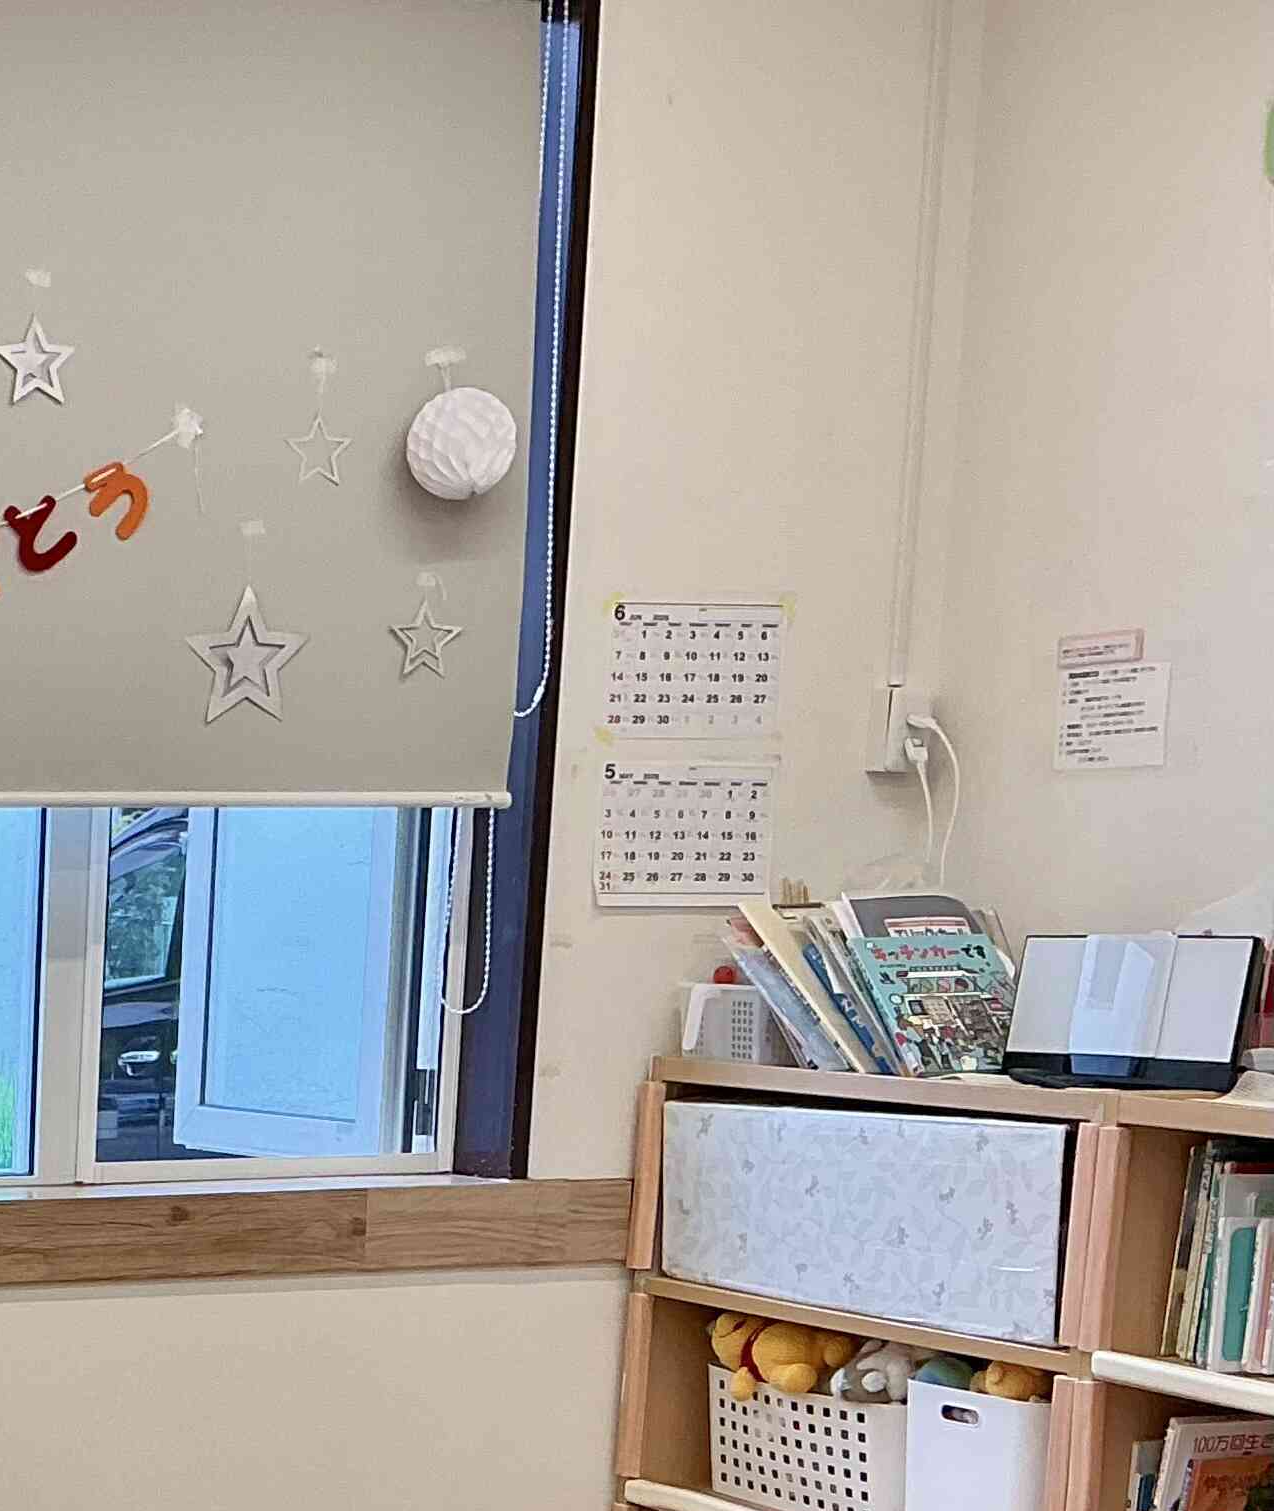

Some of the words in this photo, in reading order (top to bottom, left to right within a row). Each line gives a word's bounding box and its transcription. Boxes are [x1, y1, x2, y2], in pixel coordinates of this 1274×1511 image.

[614, 604, 626, 621] 6
[642, 630, 647, 640] 1
[665, 630, 673, 640] 2
[690, 631, 697, 640] 3
[714, 631, 721, 640] 4
[738, 631, 744, 641] 5
[761, 631, 768, 641] 6
[616, 651, 623, 660] 7
[639, 651, 646, 661] 8
[664, 651, 671, 661] 9
[685, 652, 698, 662] 10
[709, 652, 721, 662] 11
[734, 652, 746, 662] 12
[758, 652, 770, 662] 13
[611, 672, 624, 681] 14
[635, 672, 648, 682] 15
[659, 673, 672, 683] 16
[684, 673, 697, 683] 17
[707, 673, 720, 683] 18
[732, 674, 745, 683] 19
[755, 674, 768, 683] 20
[609, 694, 622, 703] 21
[634, 694, 647, 704] 22
[658, 694, 671, 704] 23
[682, 694, 695, 704] 24
[706, 694, 720, 704] 25
[730, 695, 743, 704] 26
[753, 694, 767, 705] 27
[608, 715, 622, 724] 28
[632, 715, 646, 725] 29
[657, 715, 670, 725] 30
[604, 763, 616, 779] 5
[728, 790, 735, 801] 1
[751, 790, 758, 800] 2
[605, 809, 612, 819] 3
[630, 809, 636, 819] 4
[654, 810, 661, 820] 5
[678, 810, 685, 820] 6
[701, 810, 708, 820] 7
[725, 811, 732, 820] 8
[749, 811, 756, 821] 9
[601, 830, 613, 840] 10
[625, 831, 637, 841] 11
[650, 831, 662, 841] 12
[673, 831, 686, 841] 13
[697, 831, 710, 841] 14
[721, 832, 734, 841] 15
[745, 832, 757, 842] 16
[601, 851, 613, 860] 17
[624, 852, 636, 861] 18
[648, 852, 661, 861] 19
[671, 852, 684, 861] 20
[695, 852, 708, 862] 21
[719, 852, 732, 862] 22
[743, 852, 756, 862] 23
[600, 871, 612, 881] 24
[622, 872, 636, 883] 25
[646, 872, 659, 882] 26
[670, 873, 684, 882] 27
[694, 873, 707, 882] 28
[718, 873, 731, 882] 29
[742, 873, 755, 883] 30
[600, 883, 611, 891] 31
